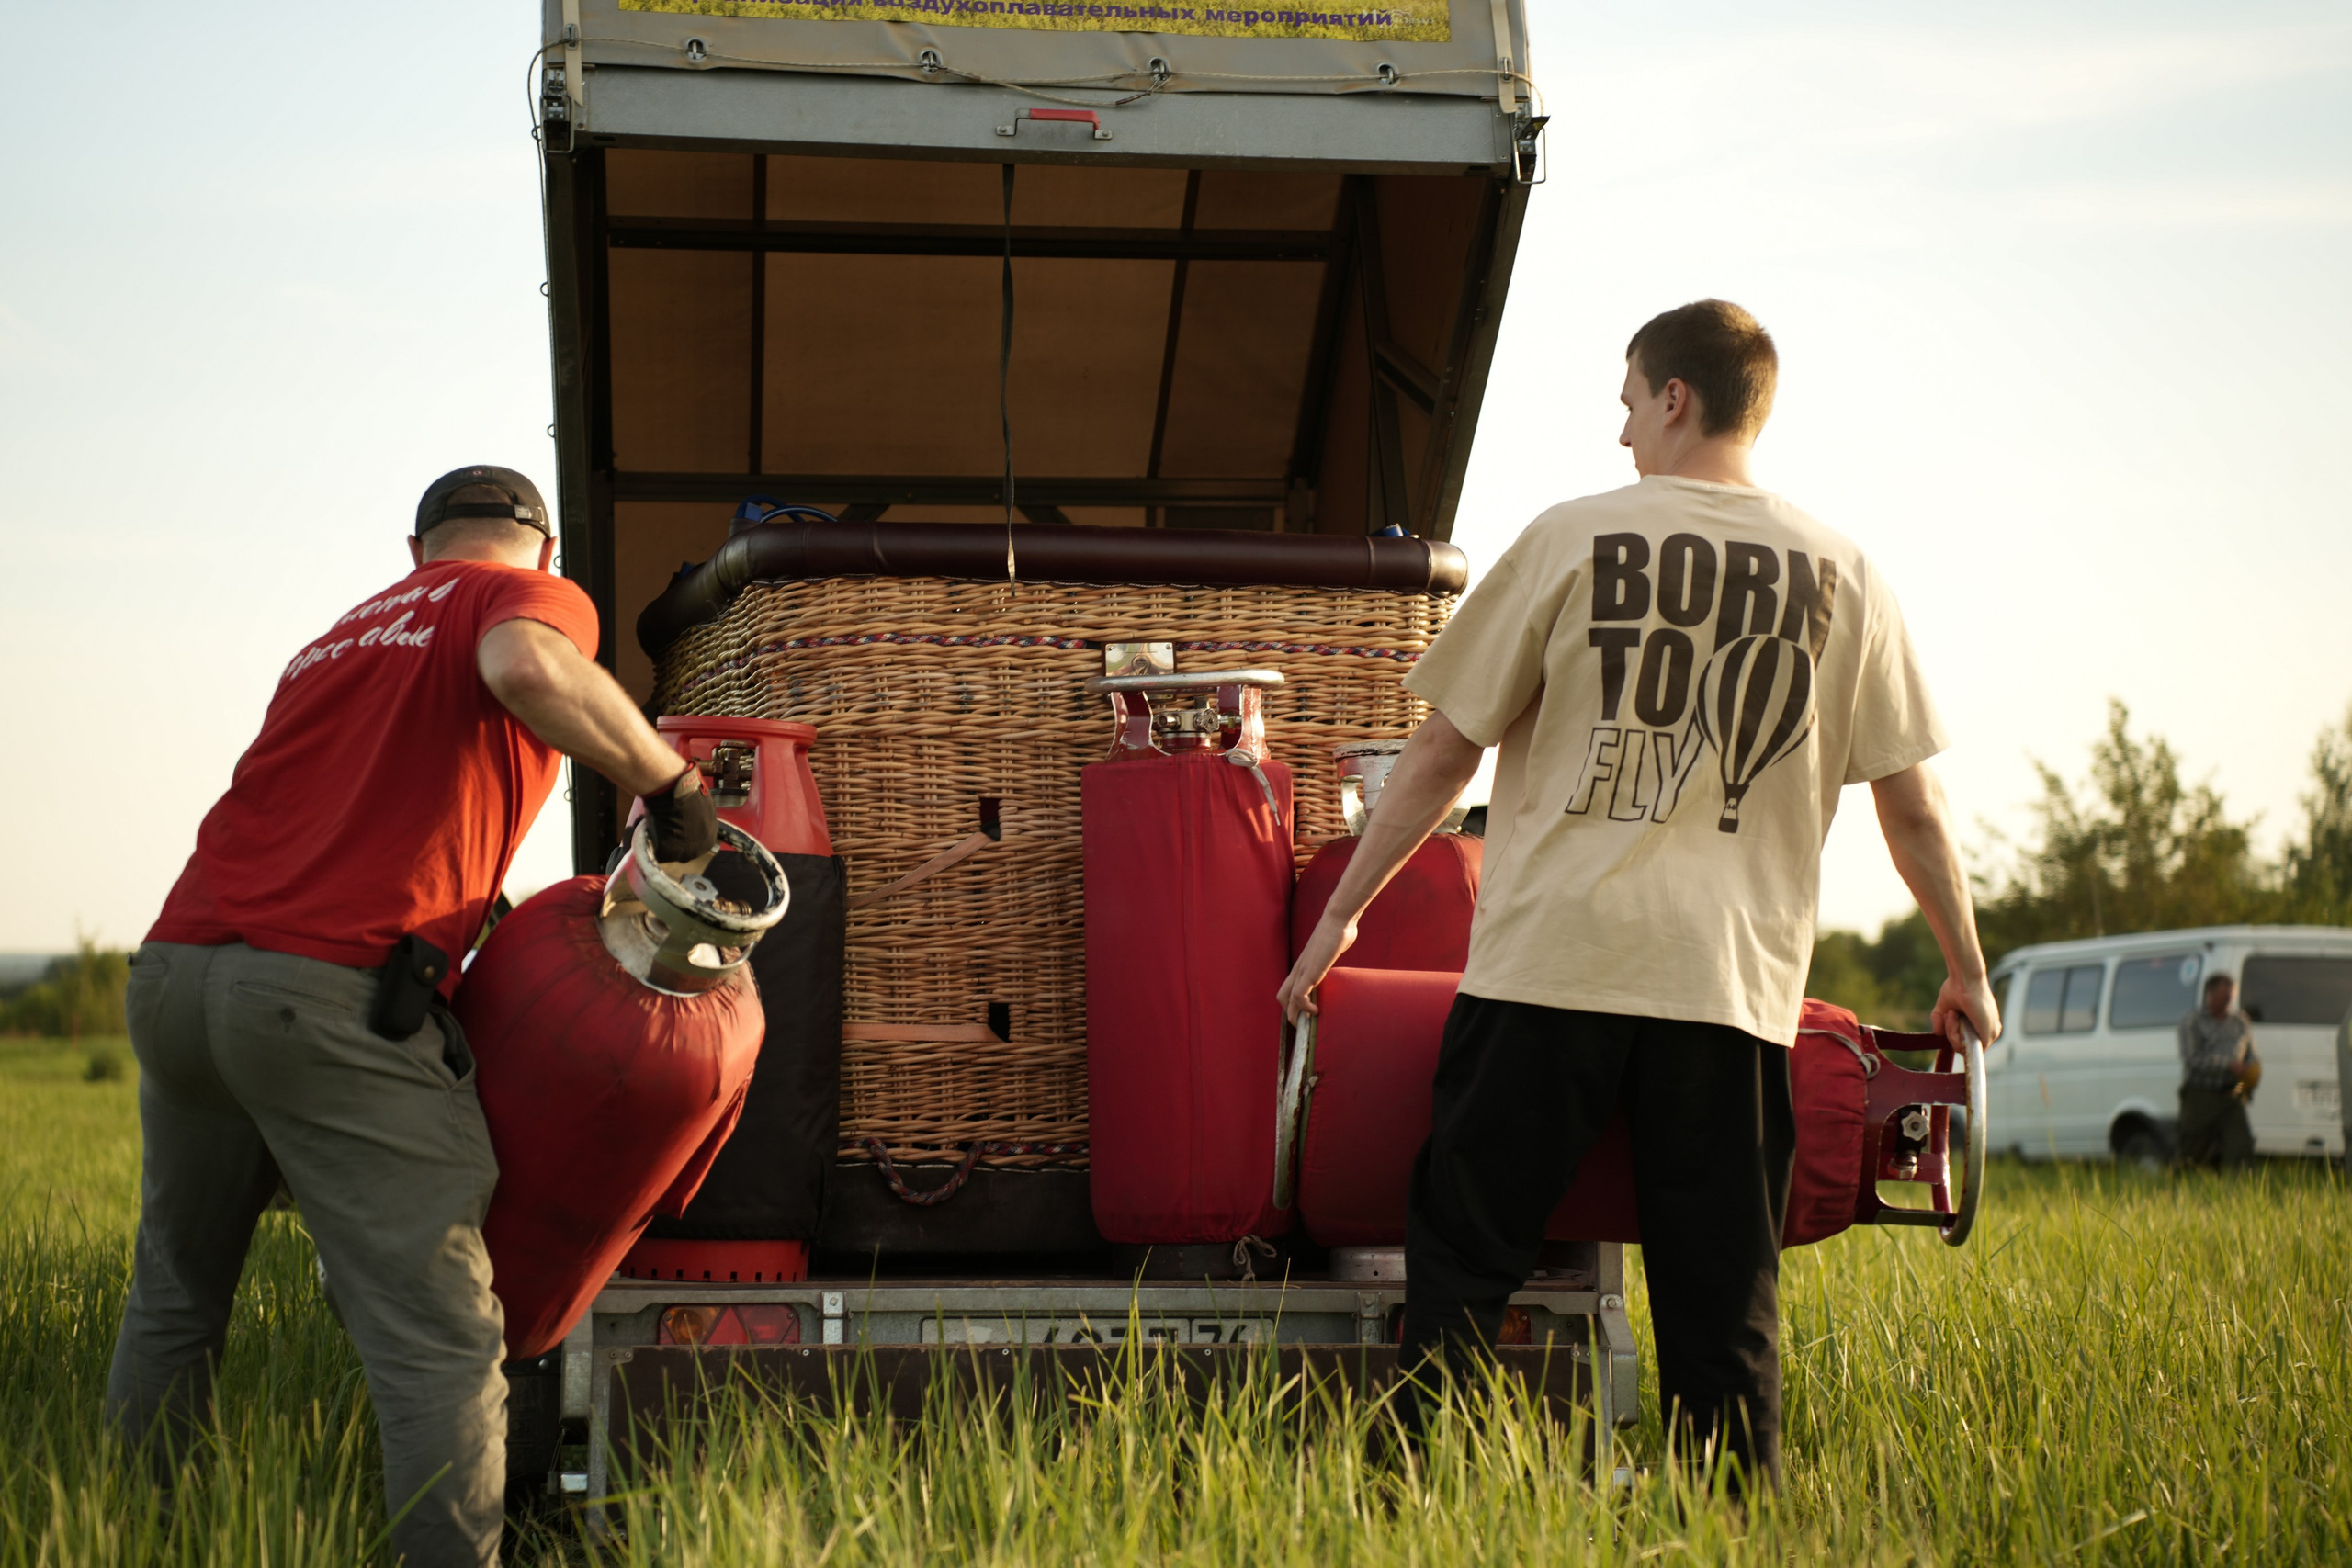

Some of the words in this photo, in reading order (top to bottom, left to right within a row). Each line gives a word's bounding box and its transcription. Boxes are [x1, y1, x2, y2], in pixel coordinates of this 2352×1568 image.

[873, 0, 1196, 20] воздухоплавательных
[1205, 8, 1392, 27] мероприятий
[1591, 532, 1836, 672] BORN
[1589, 627, 1694, 727] TO
[1564, 705, 1705, 823] FLY
